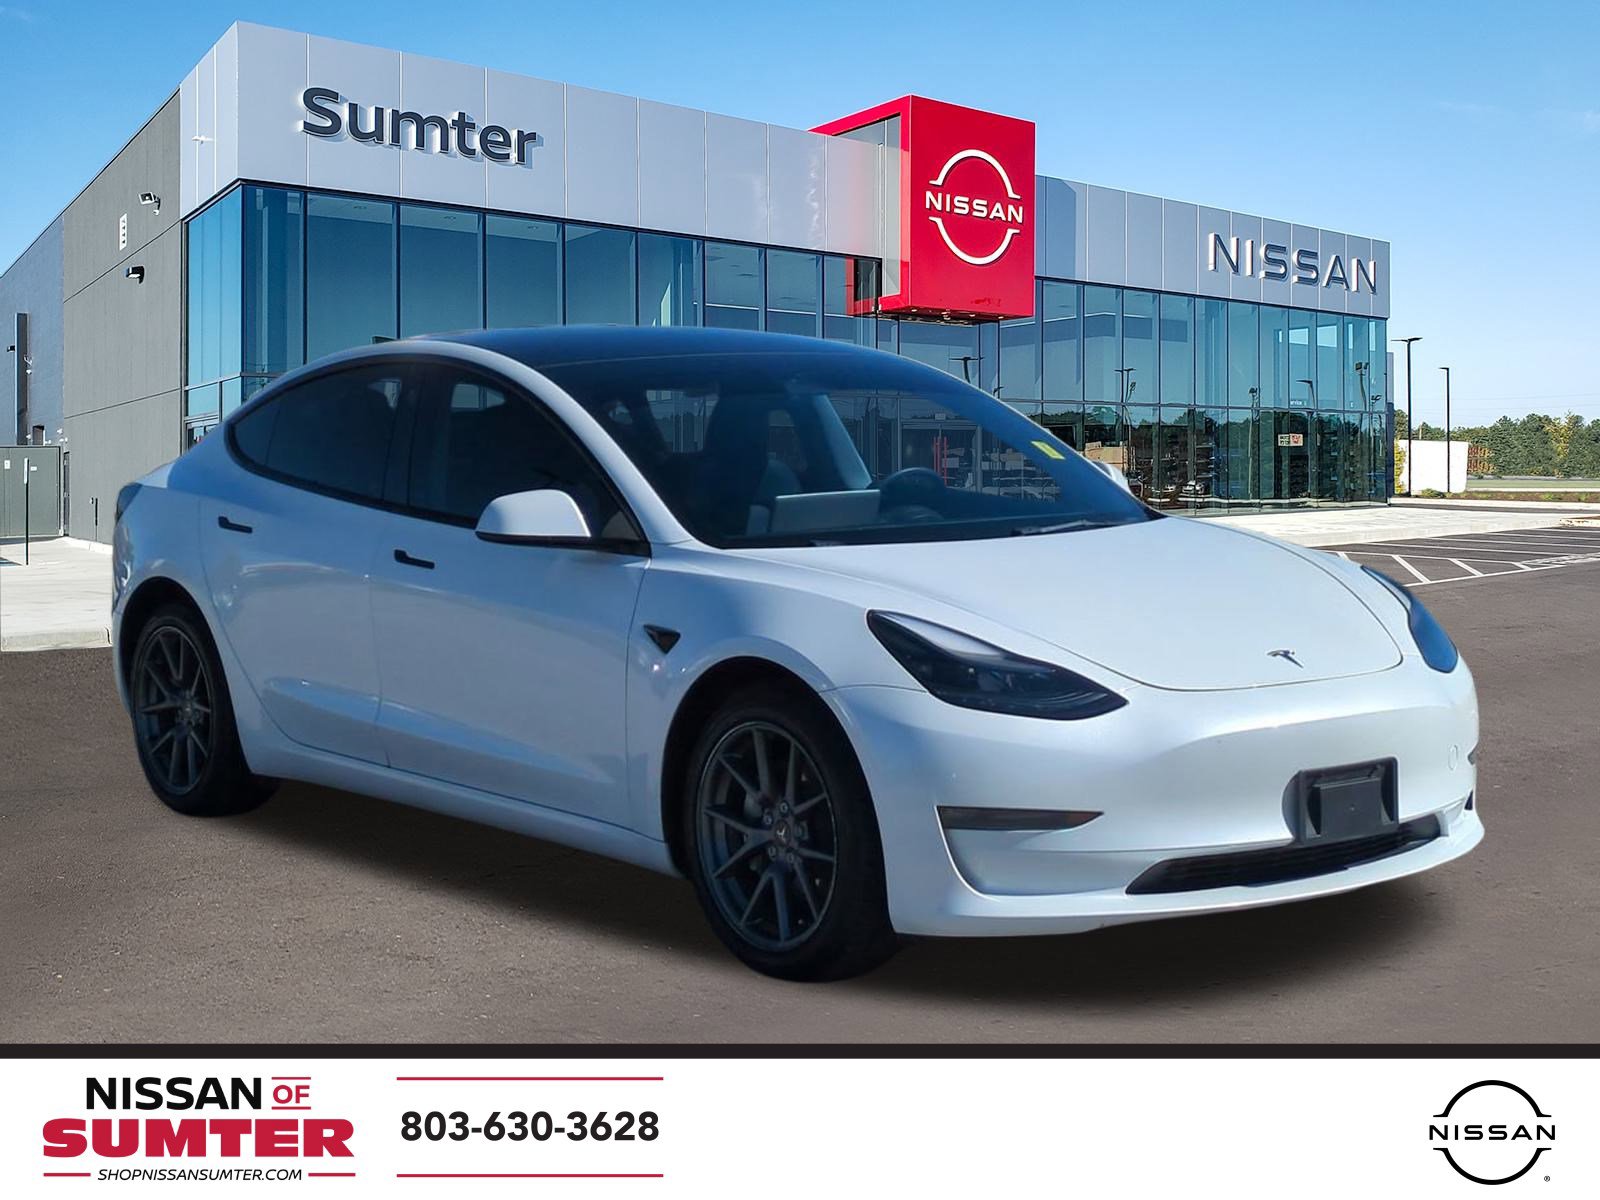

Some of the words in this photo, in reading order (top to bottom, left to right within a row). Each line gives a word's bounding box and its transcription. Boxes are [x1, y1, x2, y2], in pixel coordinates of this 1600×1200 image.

[301, 86, 538, 166] Sumter
[925, 190, 1024, 224] NISSAN
[1208, 232, 1377, 294] NISSAN
